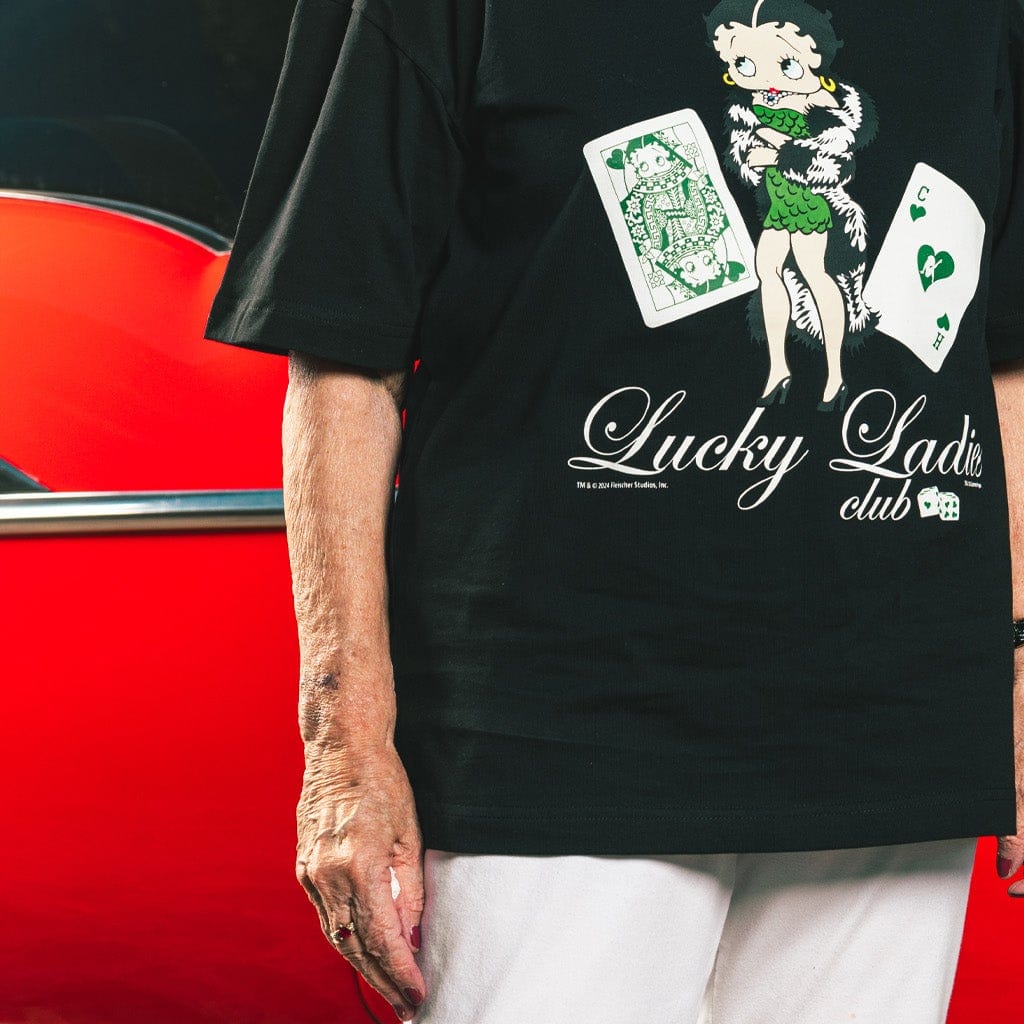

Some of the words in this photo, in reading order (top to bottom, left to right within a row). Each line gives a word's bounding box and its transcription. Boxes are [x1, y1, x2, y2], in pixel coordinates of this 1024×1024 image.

[917, 185, 930, 202] C
[568, 386, 809, 511] Lucky
[839, 477, 912, 521] club
